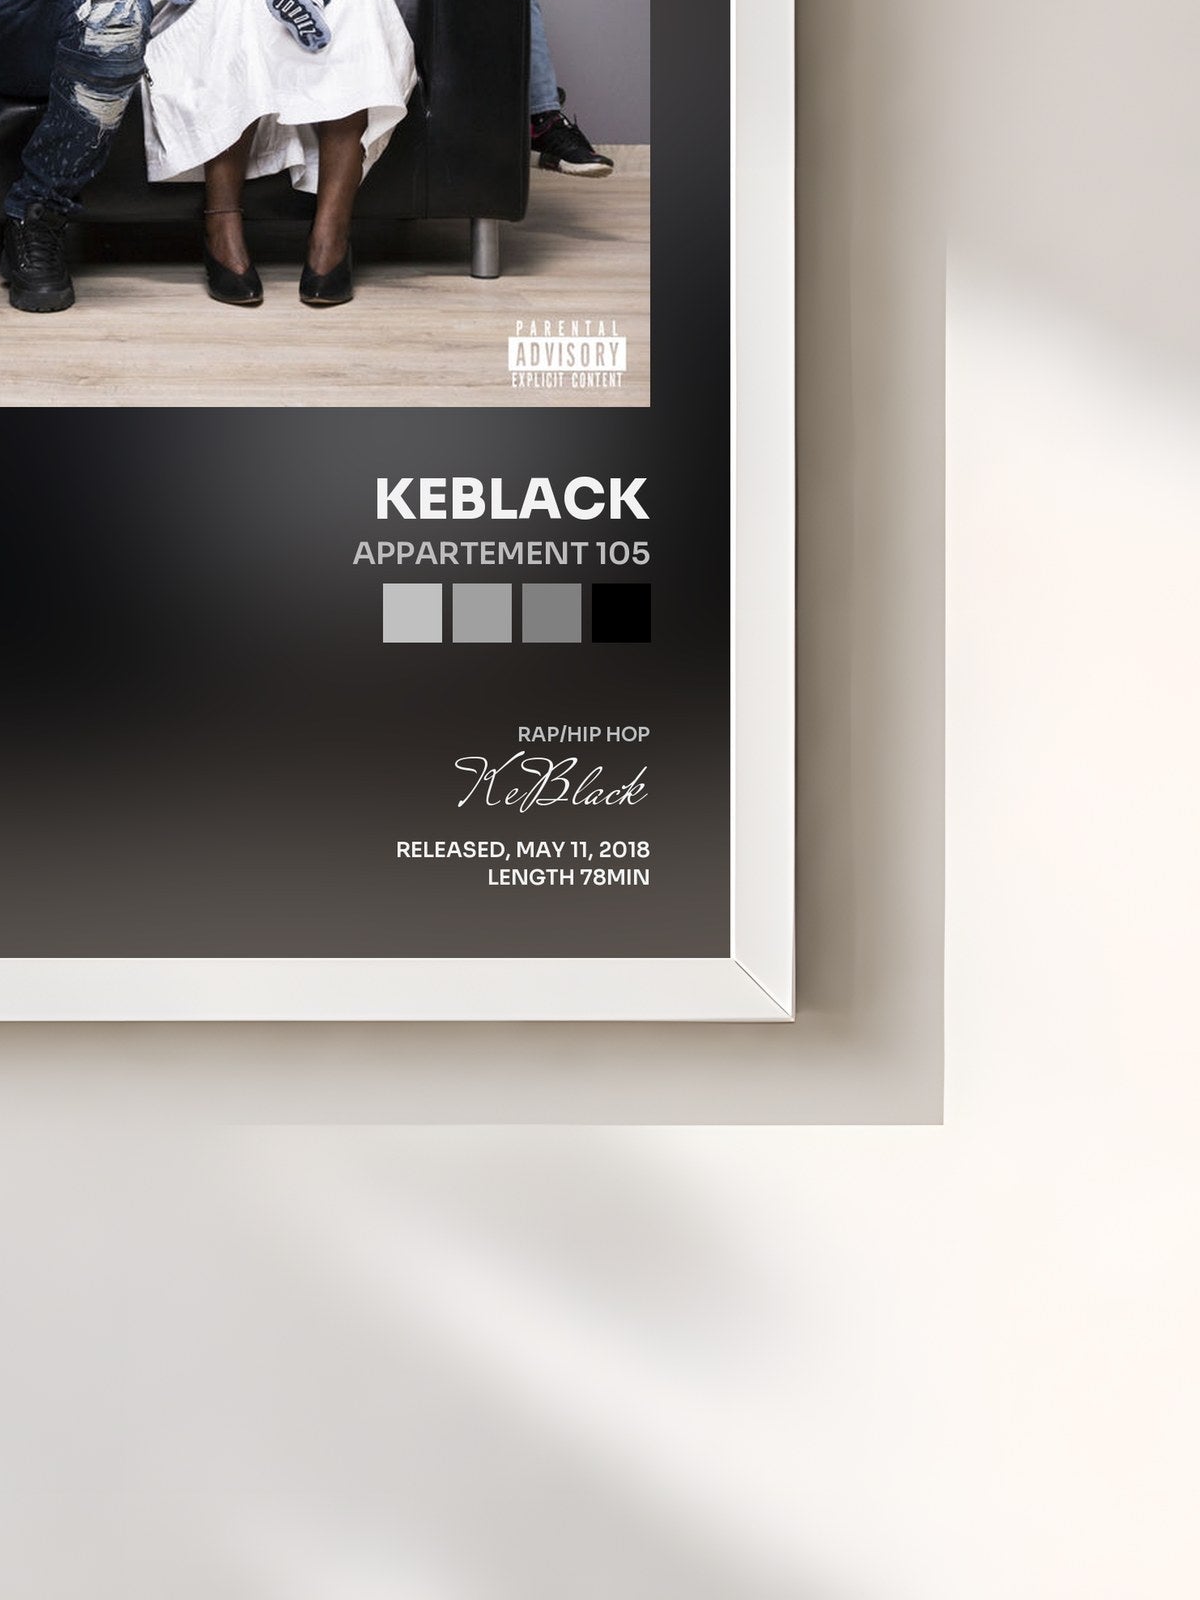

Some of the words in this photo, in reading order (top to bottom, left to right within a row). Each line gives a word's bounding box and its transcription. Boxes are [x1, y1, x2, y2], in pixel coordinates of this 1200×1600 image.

[515, 319, 619, 337] PARENTAL
[515, 341, 619, 367] ADVISORY
[512, 372, 564, 388] EXPLICIT
[571, 372, 624, 388] CONTENT
[376, 476, 650, 521] KEBLACK
[352, 540, 590, 566] APPARTEMENT
[595, 540, 651, 566] 105
[517, 725, 603, 744] RAP/HIP
[606, 725, 651, 744] HOP
[454, 750, 649, 814] KeBlack
[396, 840, 511, 862] RELEASED,
[516, 840, 566, 859] MAY
[569, 840, 595, 862] 11,
[598, 840, 651, 859] 2018
[487, 868, 575, 886] LENGTH
[579, 868, 651, 886] 78MIN
